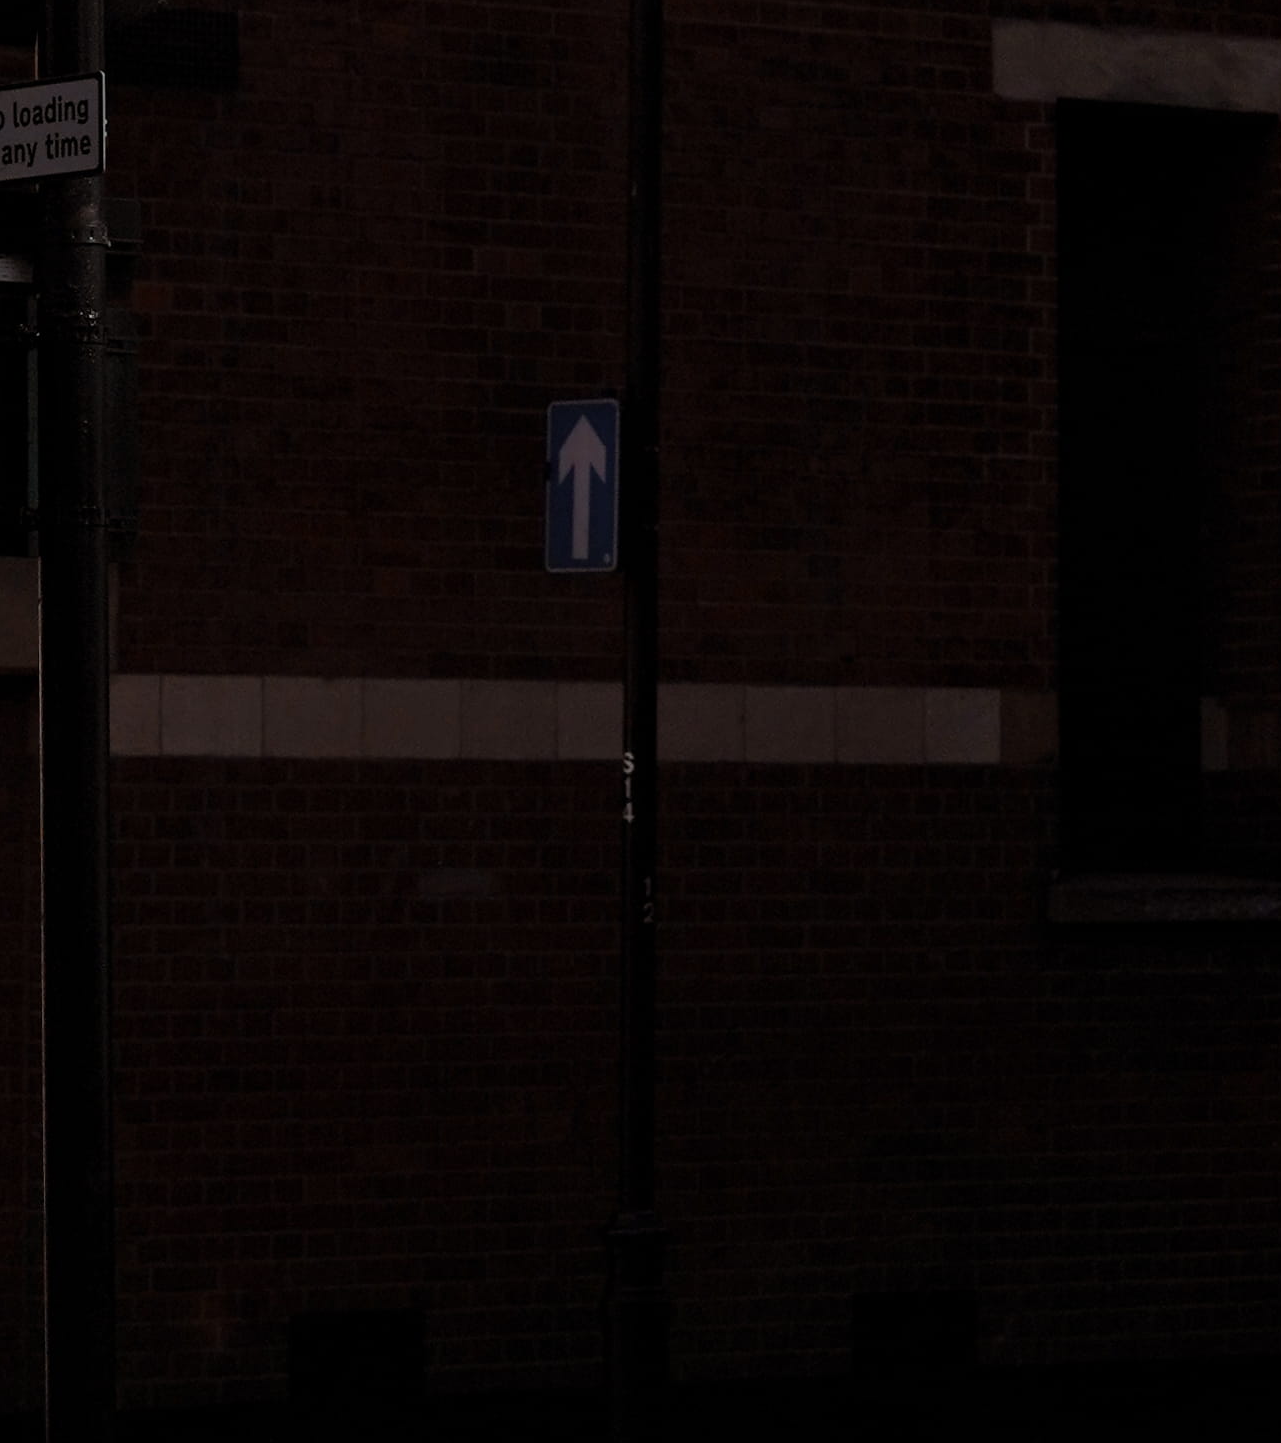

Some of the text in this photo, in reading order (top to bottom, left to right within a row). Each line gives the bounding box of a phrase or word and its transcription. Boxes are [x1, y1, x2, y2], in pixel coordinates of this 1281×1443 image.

[13, 95, 89, 128] loading
[2, 142, 37, 167] any
[45, 133, 91, 159] time
